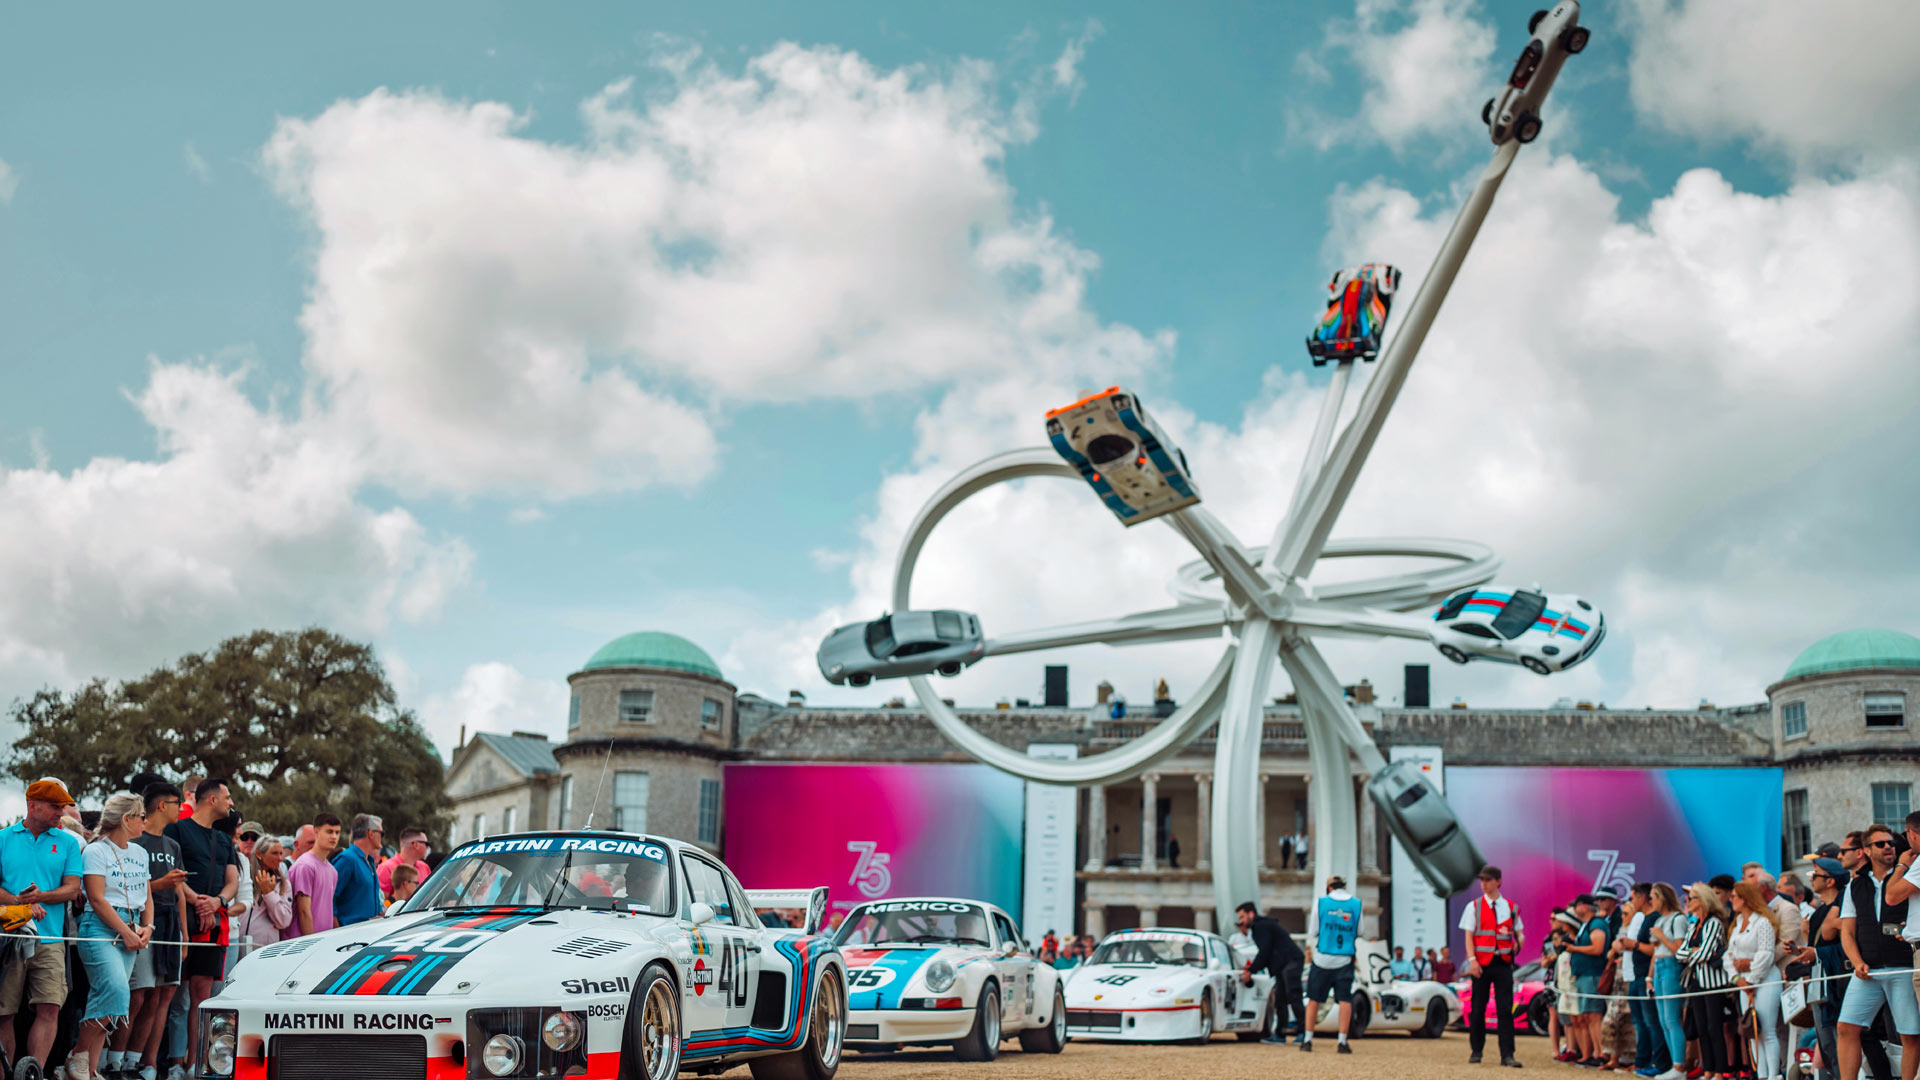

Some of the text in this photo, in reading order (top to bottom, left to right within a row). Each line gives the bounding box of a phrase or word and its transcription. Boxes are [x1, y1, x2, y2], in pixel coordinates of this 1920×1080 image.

[450, 839, 664, 862] MARTINI RACING
[847, 840, 891, 898] 75
[864, 902, 970, 915] MEXICO
[368, 930, 501, 953] 40
[718, 935, 748, 1009] 40
[847, 969, 887, 987] 95
[561, 976, 630, 994] Shell
[588, 1003, 625, 1017] BOSCH
[264, 1013, 434, 1030] MARTINI RACING
